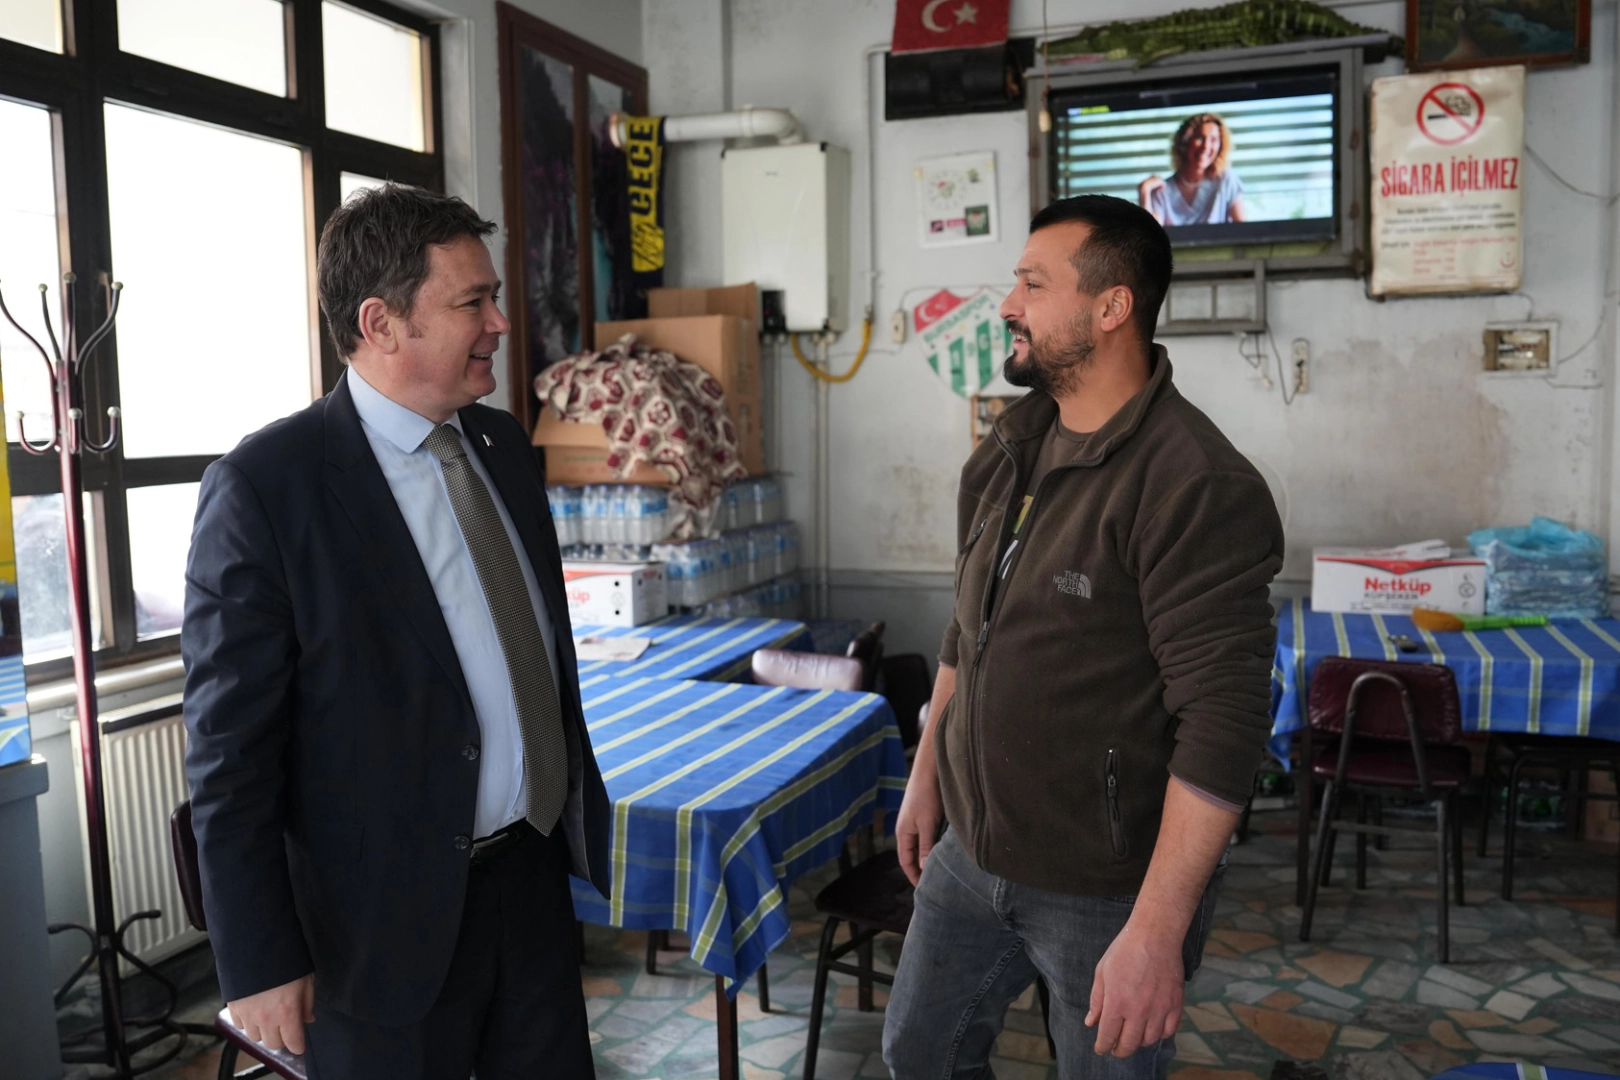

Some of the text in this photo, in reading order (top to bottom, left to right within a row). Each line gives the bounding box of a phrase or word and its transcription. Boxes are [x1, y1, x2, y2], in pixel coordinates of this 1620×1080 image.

[1381, 154, 1519, 197] SİGARA İÇİLMEZ
[1052, 574, 1079, 588] NORTH
[1064, 570, 1080, 581] THE
[1057, 584, 1077, 596] FACE
[1365, 577, 1432, 596] Netküp
